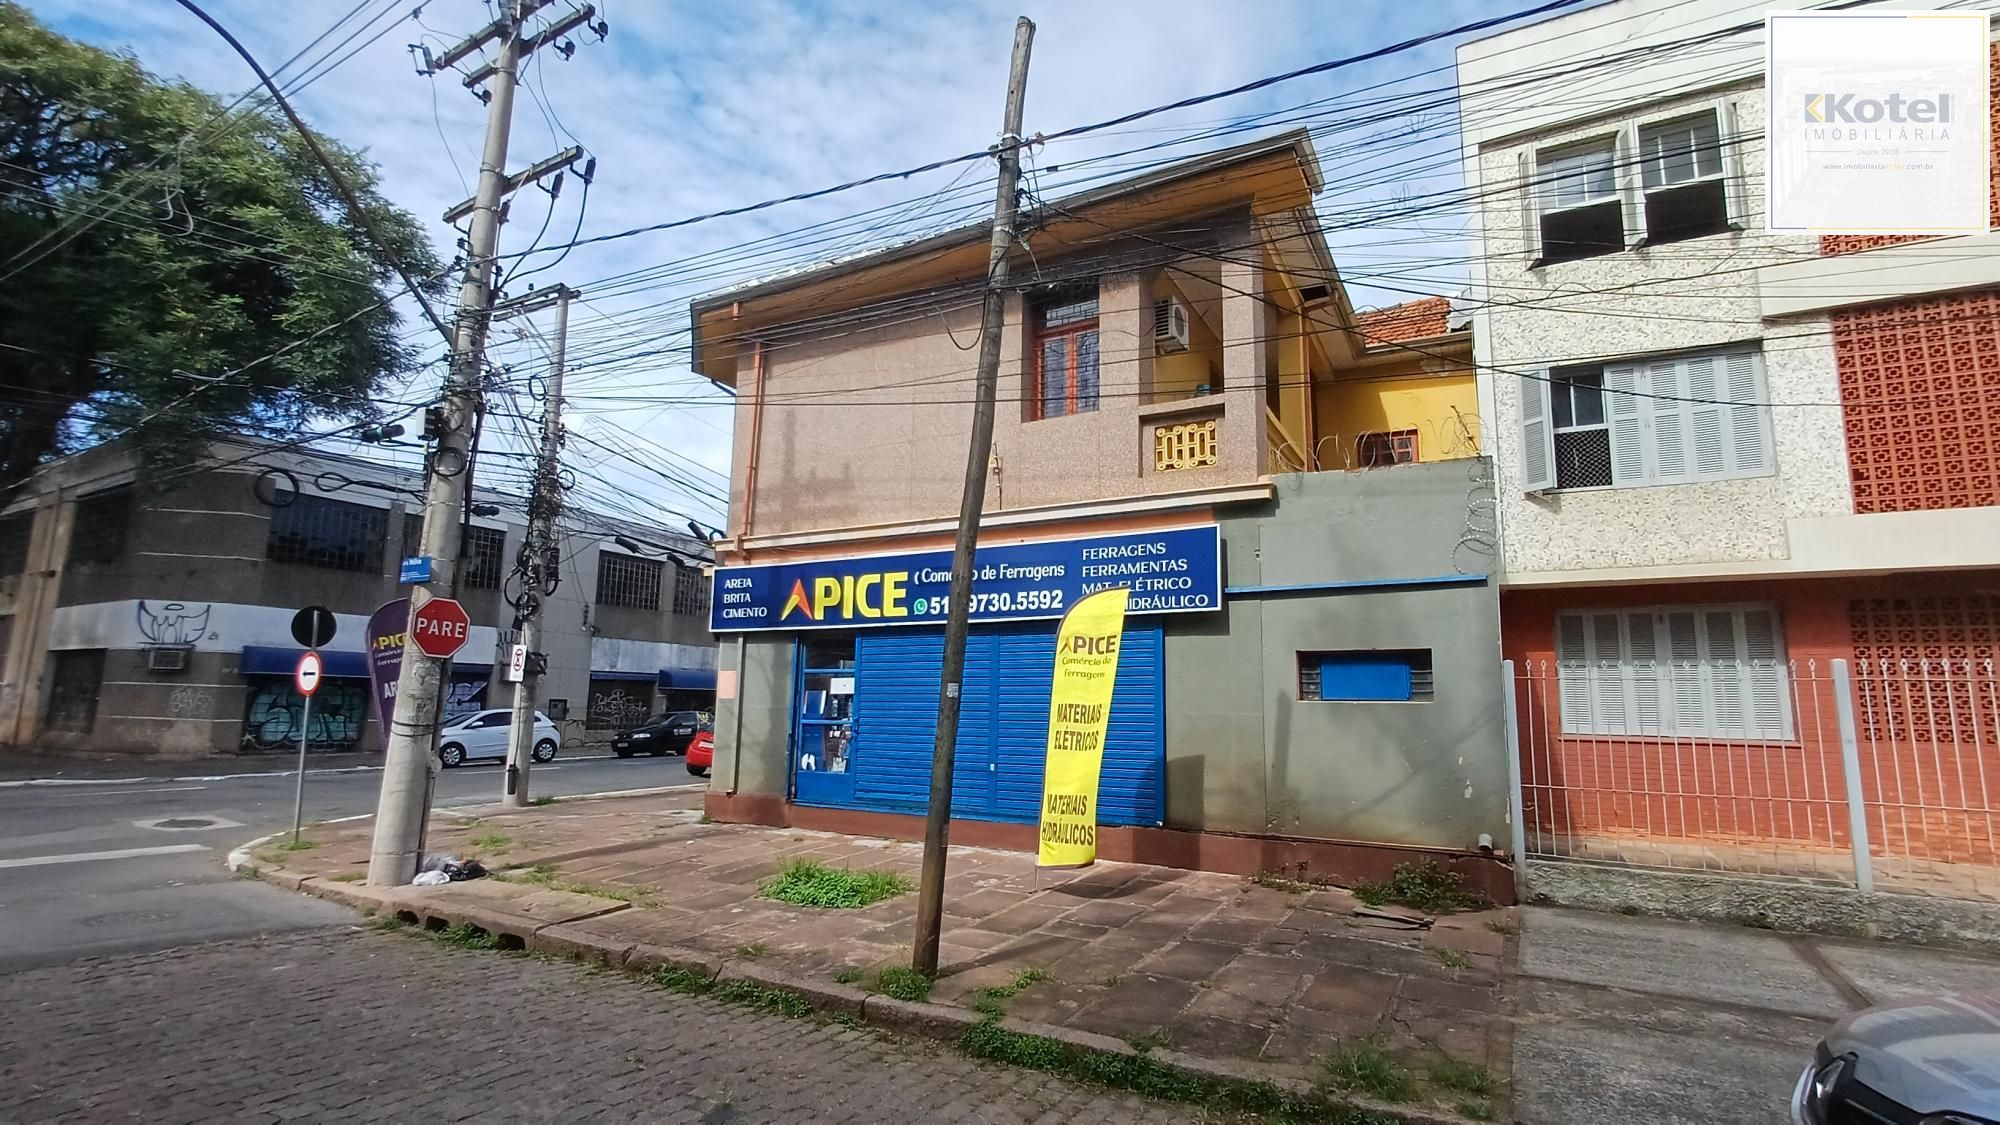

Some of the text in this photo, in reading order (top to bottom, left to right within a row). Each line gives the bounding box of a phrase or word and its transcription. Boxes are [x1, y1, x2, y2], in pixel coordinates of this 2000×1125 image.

[1082, 542, 1167, 560] FERRAGENS
[981, 564, 996, 580] de
[1000, 563, 1065, 581] Ferragens
[1082, 558, 1188, 577] FERRAMENTAS
[723, 577, 753, 589] AREIA
[723, 592, 752, 604] BRITA
[781, 571, 909, 621] APICE
[1125, 594, 1209, 610] IDRÁULICO
[722, 606, 768, 619] CIMENTO
[416, 617, 466, 639] PARE
[1060, 635, 1117, 655] APICE
[1062, 656, 1101, 666] Comércio
[1057, 703, 1103, 724] MATERIAIS
[1054, 725, 1099, 752] ELÉTRICOS
